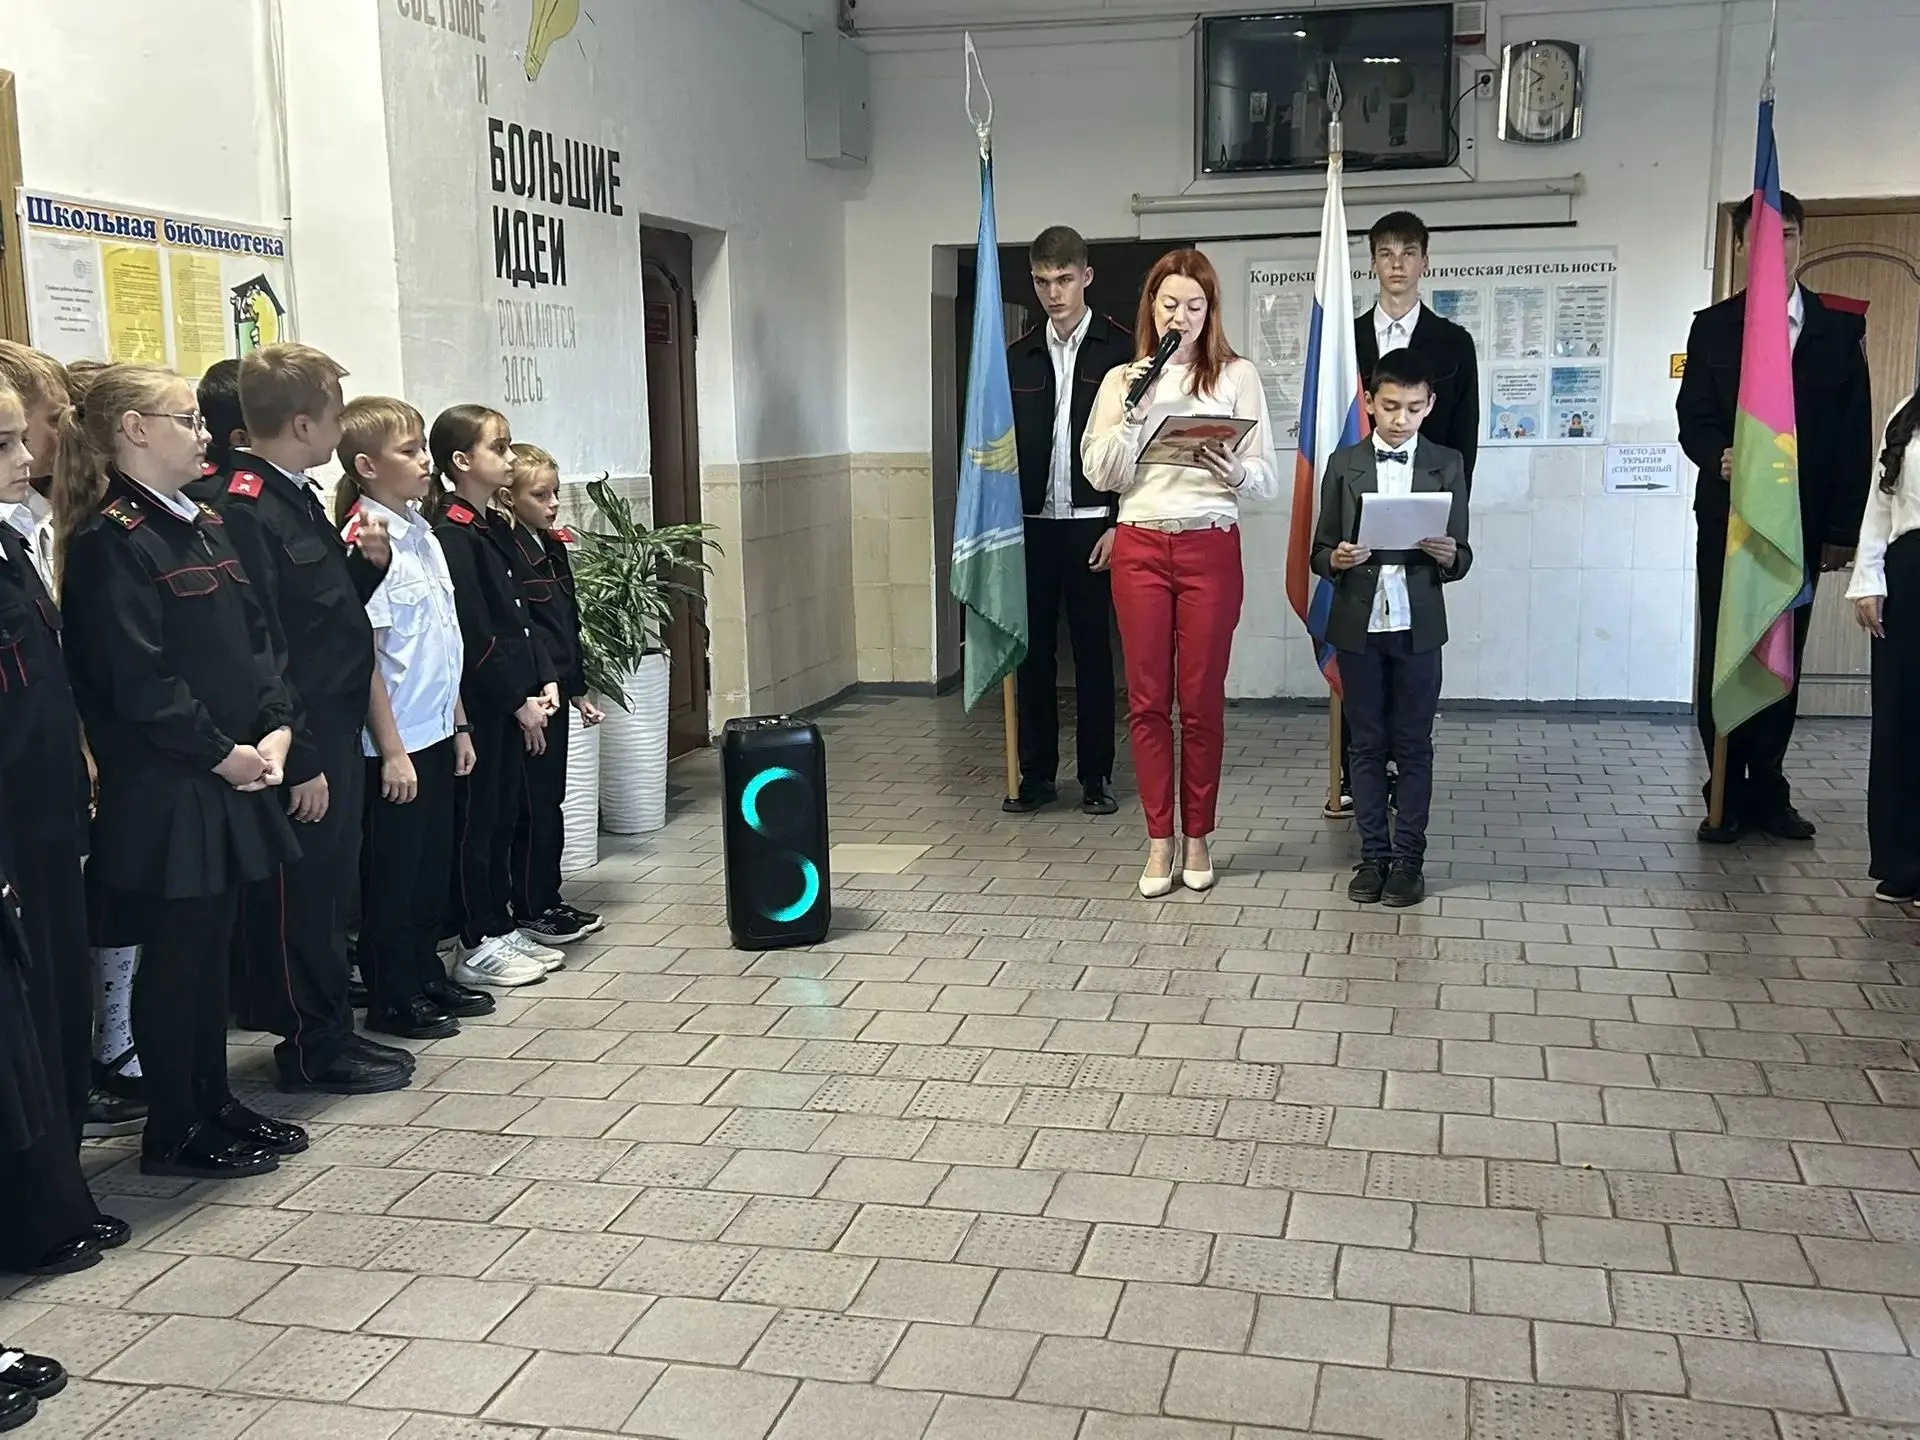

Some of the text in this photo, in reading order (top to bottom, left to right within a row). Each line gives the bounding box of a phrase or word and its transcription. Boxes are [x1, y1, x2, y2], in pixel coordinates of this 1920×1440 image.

[476, 54, 488, 105] И
[488, 117, 623, 217] БОЛЬШИЕ
[26, 196, 284, 256] Школьная библиотека
[492, 205, 567, 288] ИДЕИ
[497, 298, 576, 350] РОЖДАЮТСЯ
[502, 355, 543, 407] ЗДЕСЬ
[1649, 448, 1666, 456] ДЛЯ
